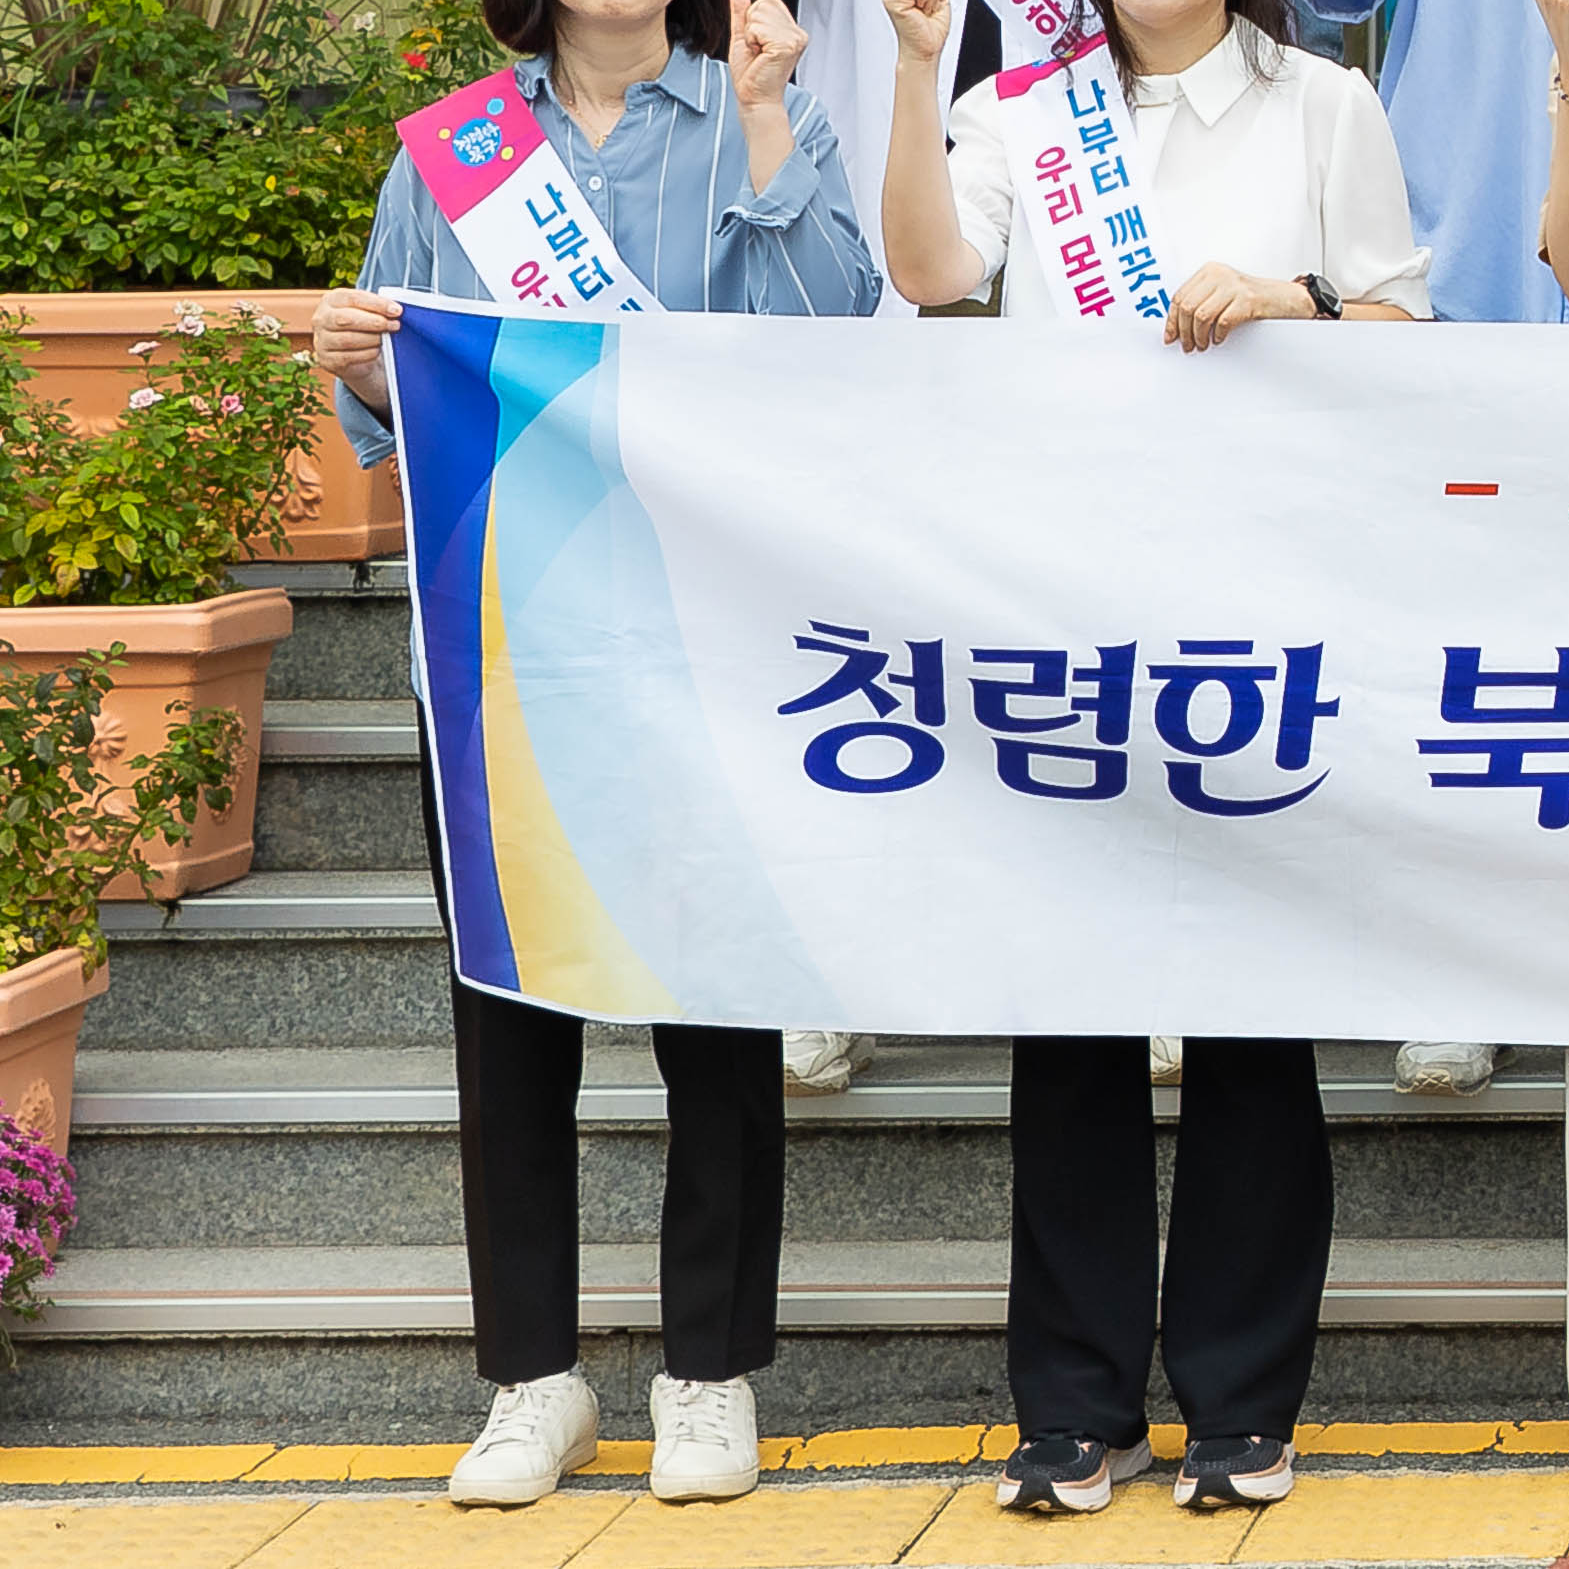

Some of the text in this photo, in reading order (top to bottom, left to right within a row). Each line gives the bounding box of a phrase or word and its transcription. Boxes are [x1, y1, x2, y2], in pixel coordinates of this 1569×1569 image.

[1066, 79, 1130, 196] 나부터
[525, 182, 614, 302] 나부터
[1035, 146, 1116, 318] 우리 모두
[779, 620, 1340, 818] 청렴한
